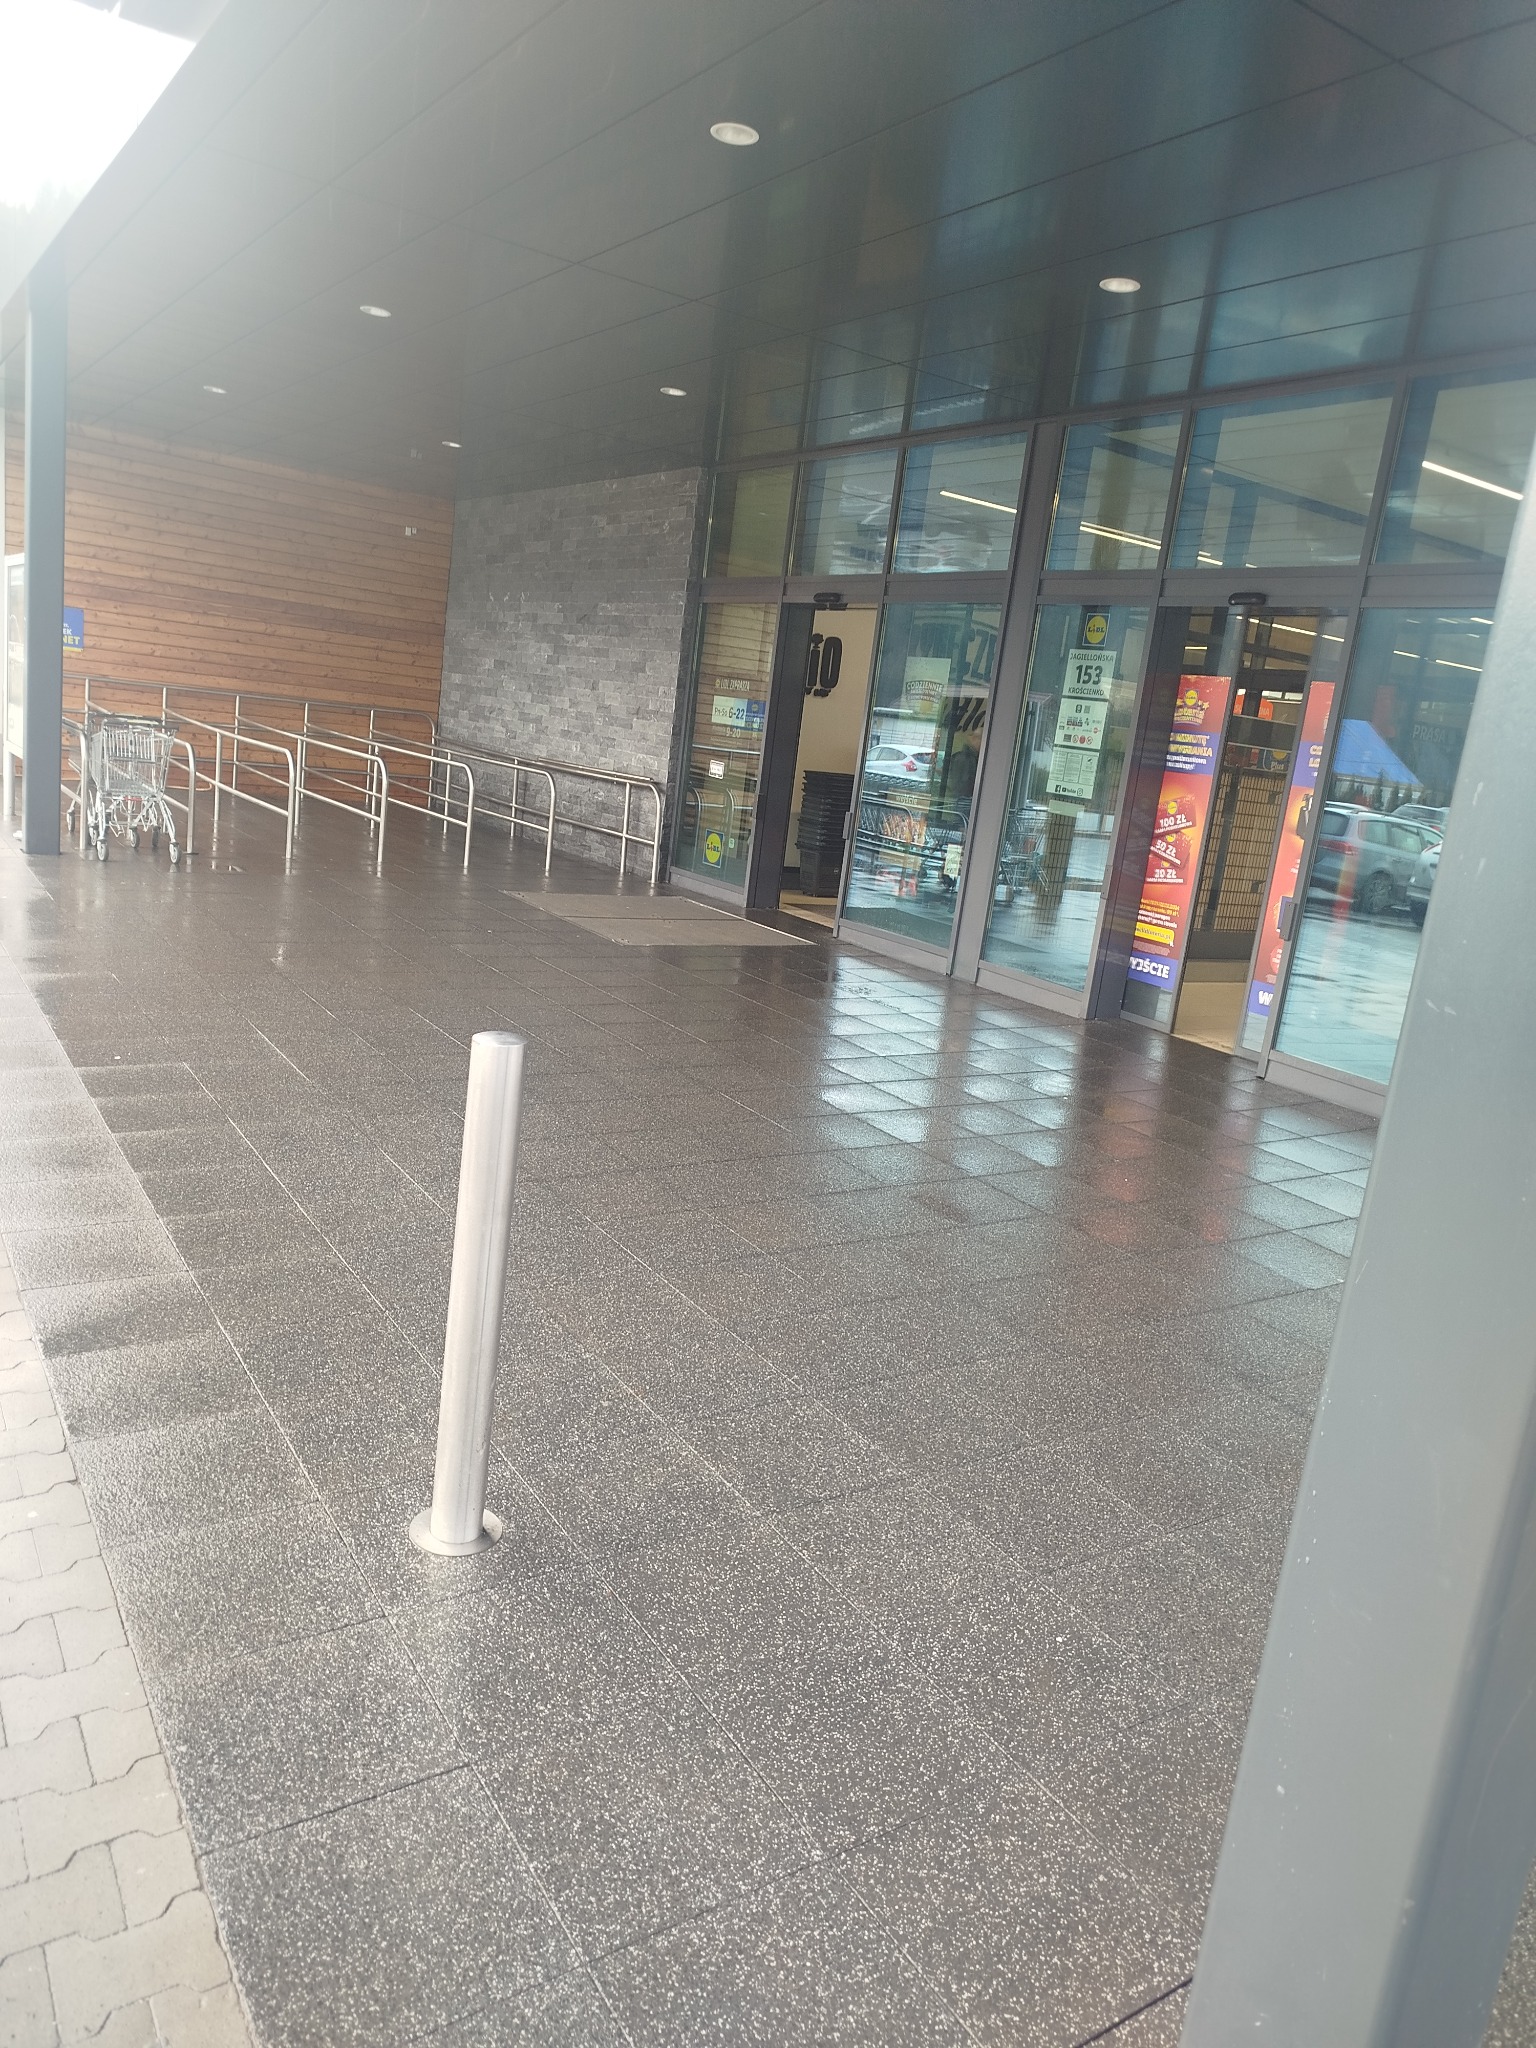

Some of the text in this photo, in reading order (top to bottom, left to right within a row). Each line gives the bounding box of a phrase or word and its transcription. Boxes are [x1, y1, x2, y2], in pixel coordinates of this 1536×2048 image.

[1069, 652, 1114, 662] JAGIELLOŃSKA
[1075, 664, 1103, 685] 153
[1067, 686, 1105, 696] KROŚCIENKO
[728, 707, 745, 720] 6-22
[726, 727, 741, 738] 9-20
[1160, 817, 1175, 827] 100
